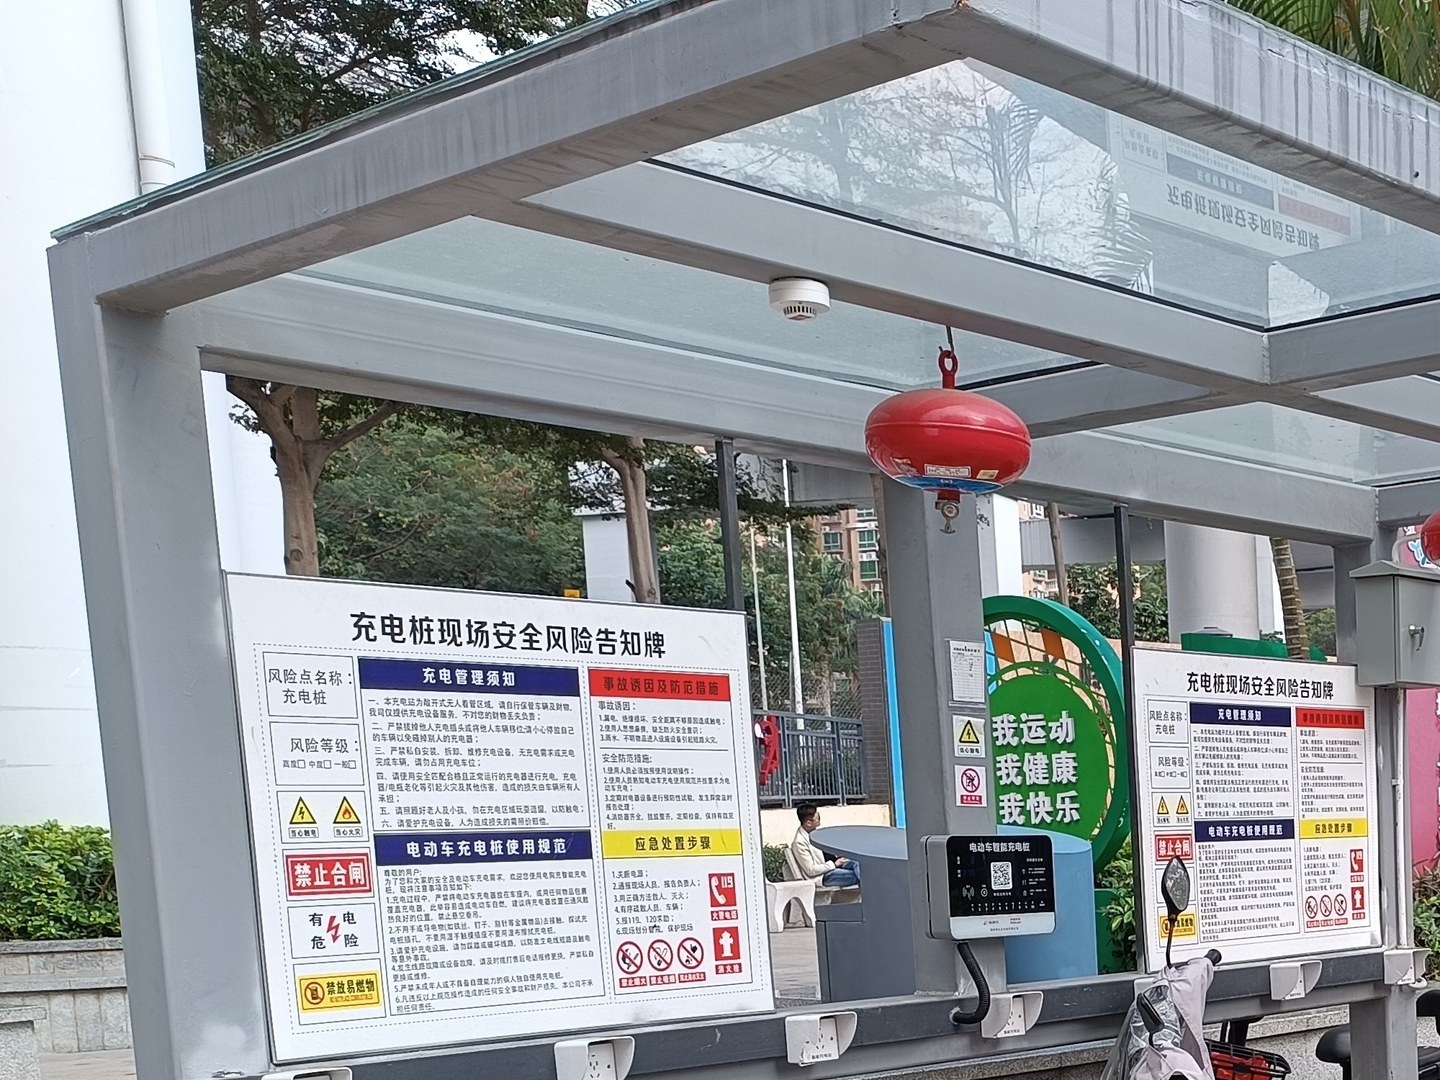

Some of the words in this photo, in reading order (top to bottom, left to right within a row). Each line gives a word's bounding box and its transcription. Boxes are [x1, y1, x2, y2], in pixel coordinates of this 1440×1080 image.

[350, 611, 666, 659] 充电桩现场安全风险告知牌
[421, 667, 516, 687] 充电管理须知
[603, 676, 720, 696] 事故诱因及防范措施
[1186, 671, 1335, 700] 充电桩现场安全风险告知牌
[282, 689, 327, 705] 充电桩
[1217, 708, 1262, 721] 充电管理须知
[991, 711, 1076, 746] 我运动
[996, 750, 1080, 786] 我健康
[998, 790, 1082, 825] 我快乐
[1208, 825, 1283, 838] 电动车充电桩使用规范
[406, 838, 567, 858] 电动车充电桩使用规范
[635, 836, 712, 851] 应急处置步骤
[969, 842, 1031, 853] 电动车智能充电桩
[1158, 838, 1191, 856] 禁止合闸
[294, 861, 366, 888] 禁止合闸
[309, 912, 324, 927] 有
[342, 910, 357, 925] 电
[311, 936, 326, 950] 危
[344, 934, 359, 948] 险
[326, 978, 375, 996] 禁放易燃物
